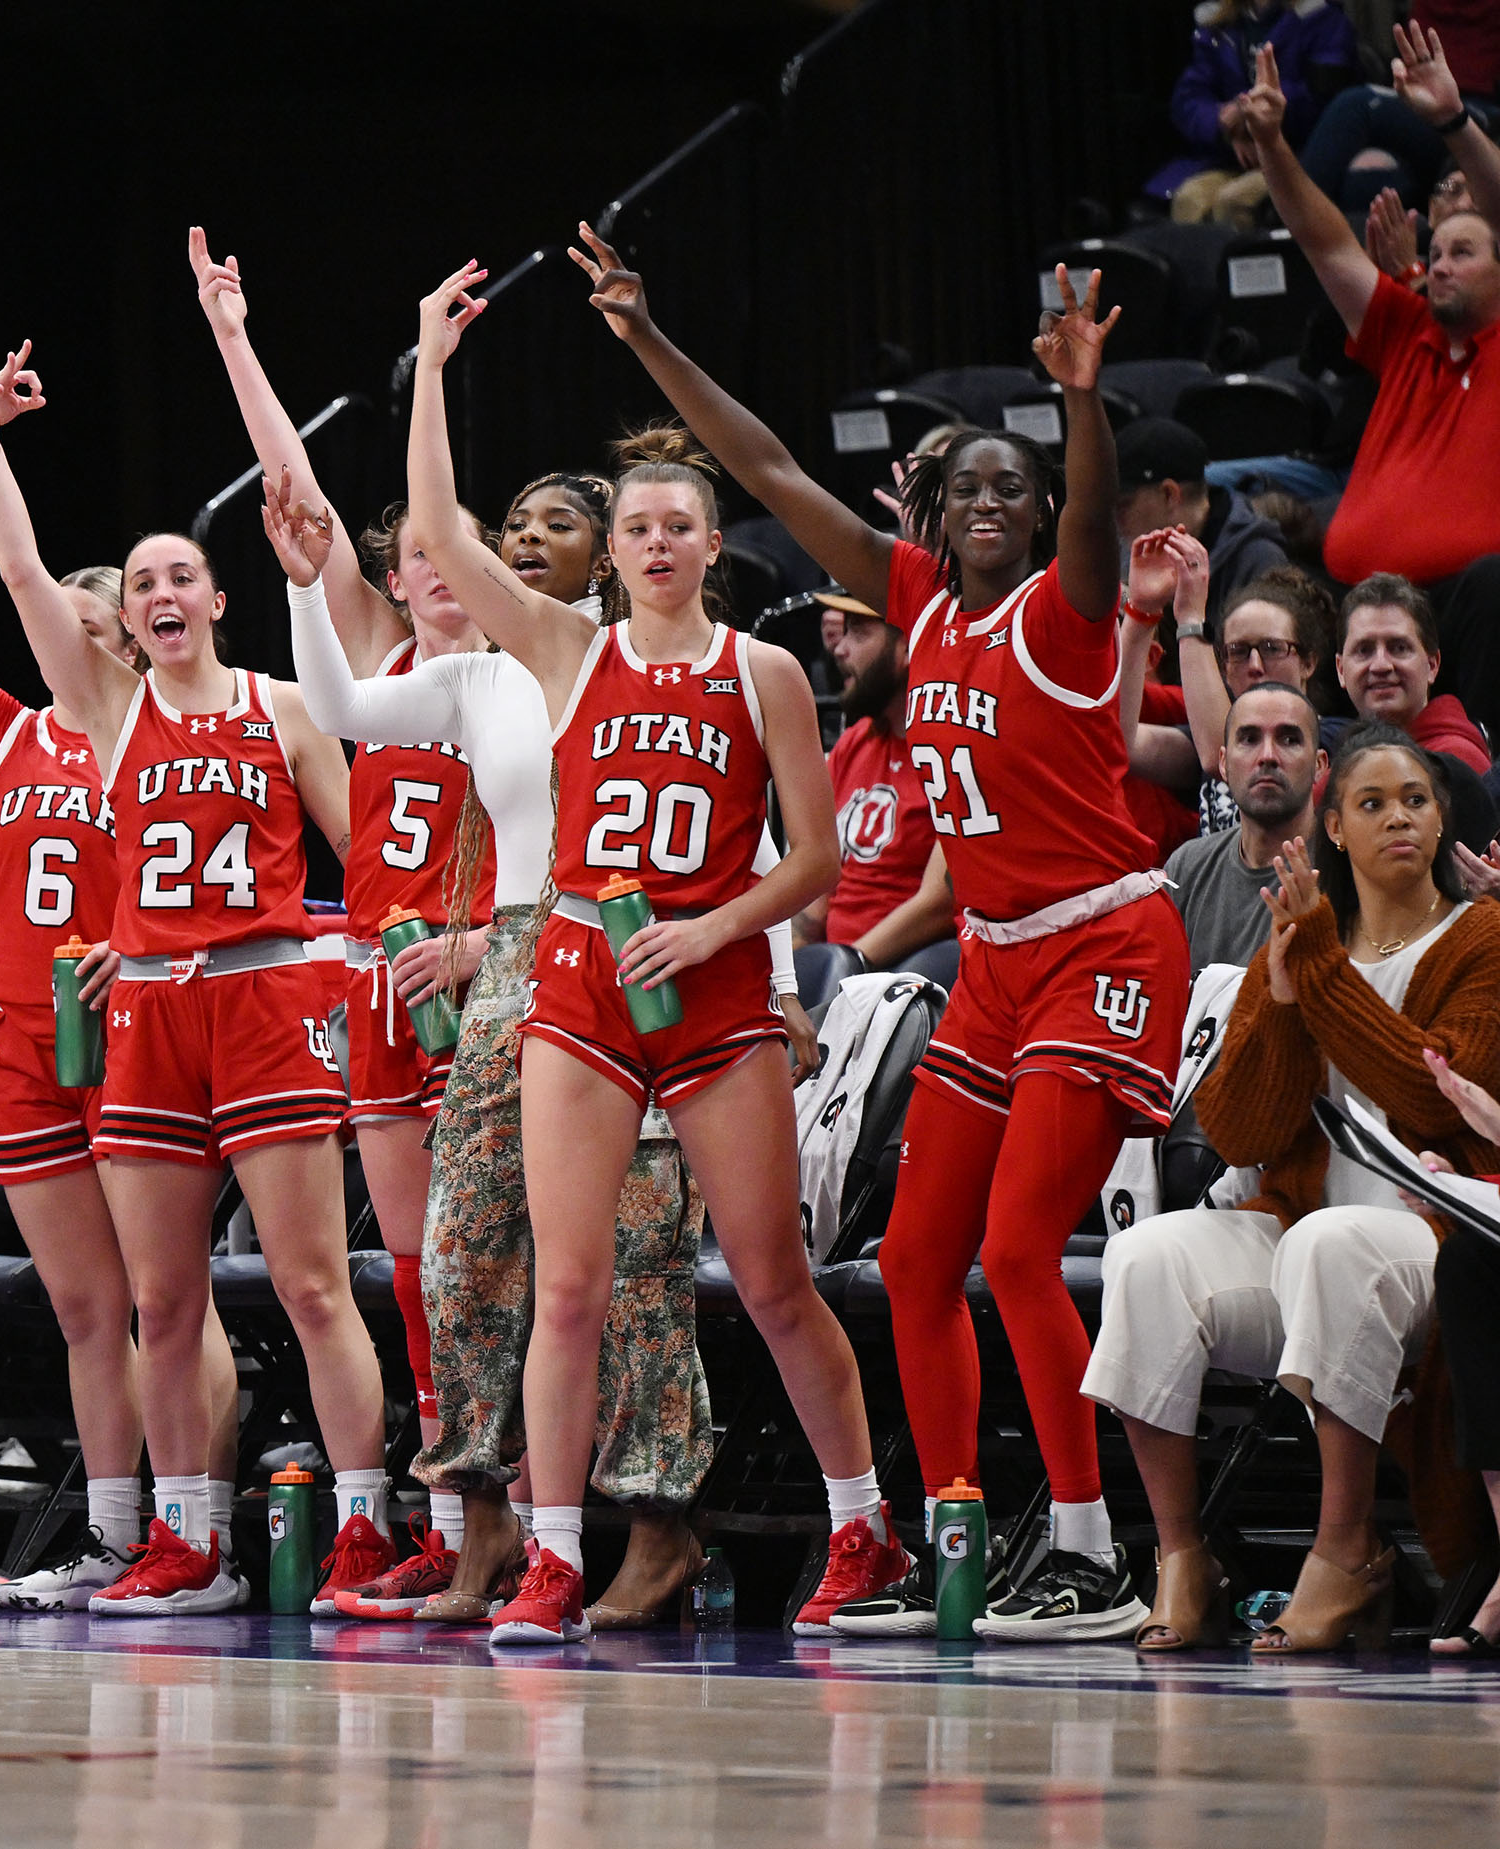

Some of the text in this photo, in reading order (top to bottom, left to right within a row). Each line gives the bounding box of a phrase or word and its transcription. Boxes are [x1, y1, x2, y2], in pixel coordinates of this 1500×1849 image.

[591, 713, 732, 778] UTAH
[904, 681, 999, 739] UTAH
[137, 757, 269, 811] UTAH
[911, 744, 1002, 838] 21
[381, 778, 443, 872] 5
[585, 778, 714, 875] 20
[24, 836, 79, 926] 6
[139, 820, 257, 908] 24
[268, 1506, 287, 1540] G
[938, 1524, 969, 1560] G
